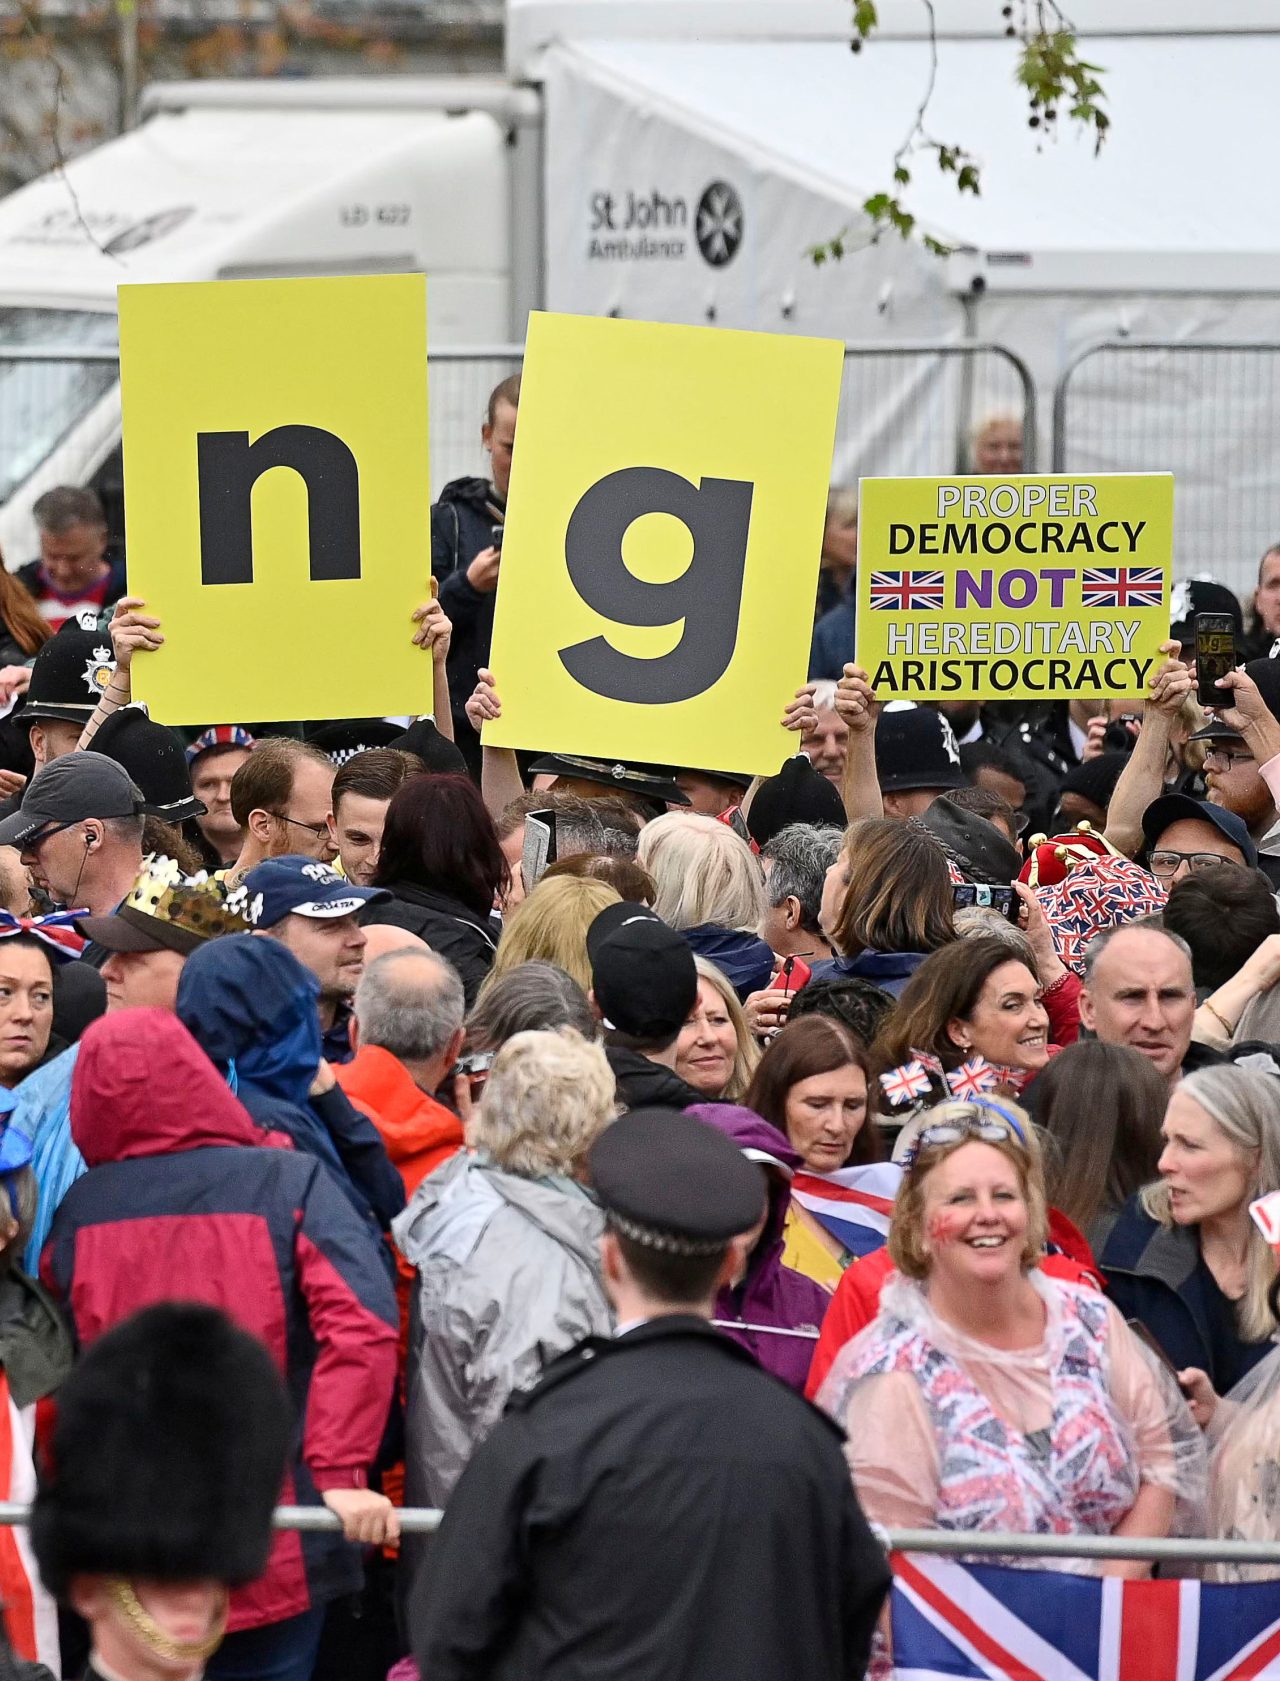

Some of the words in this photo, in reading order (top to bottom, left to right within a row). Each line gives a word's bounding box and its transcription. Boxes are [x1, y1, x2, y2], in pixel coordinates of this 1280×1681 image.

[590, 189, 616, 230] St
[624, 187, 687, 230] John
[588, 237, 686, 260] Ambulance
[197, 425, 361, 585] n
[937, 484, 1099, 518] PROPER
[889, 521, 1147, 555] DEMOCRACY
[558, 467, 754, 704] g
[954, 568, 1076, 609] NOT
[887, 621, 1141, 655] HEREDITARY
[871, 658, 1153, 692] ARISTOCRACY
